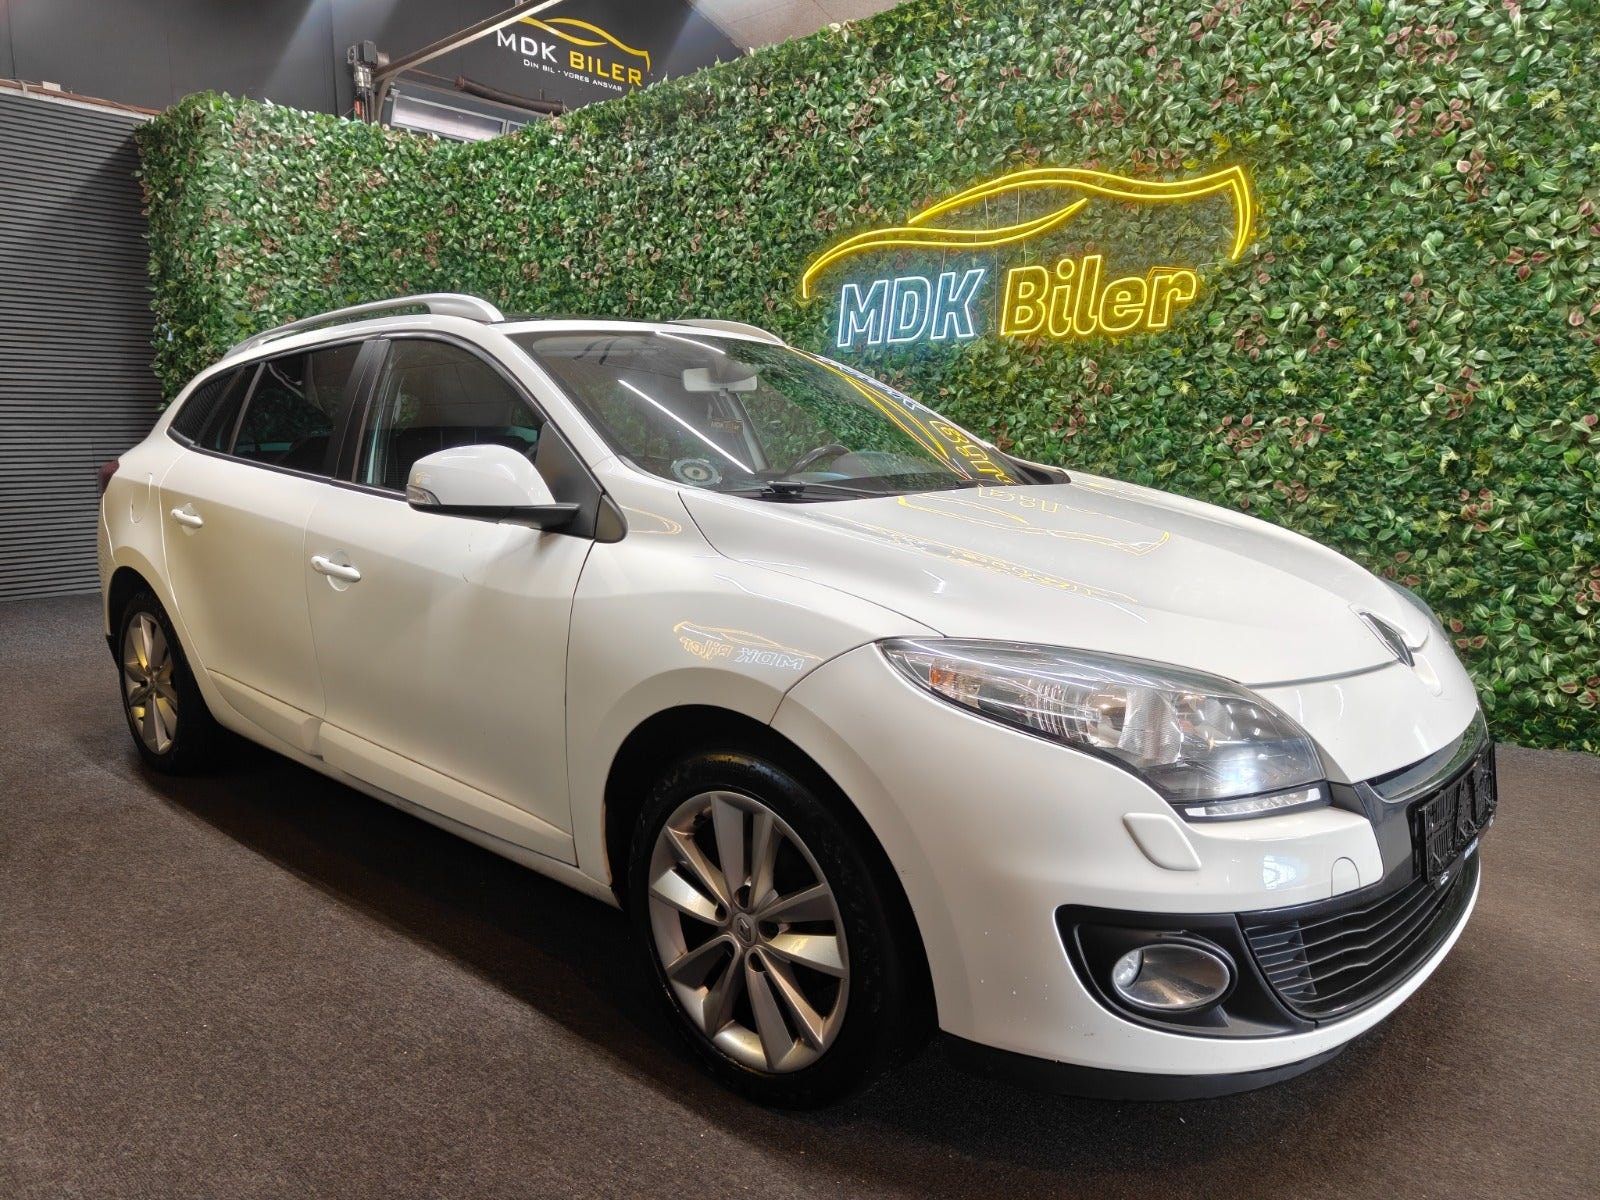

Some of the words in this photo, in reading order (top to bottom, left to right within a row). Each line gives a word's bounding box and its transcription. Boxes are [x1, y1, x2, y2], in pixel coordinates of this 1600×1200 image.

[496, 28, 558, 64] MDK
[569, 50, 643, 87] BILER
[563, 70, 590, 83] VORES
[592, 79, 623, 92] ANSVAR
[837, 267, 986, 348] MDK
[1000, 254, 1197, 338] Biler
